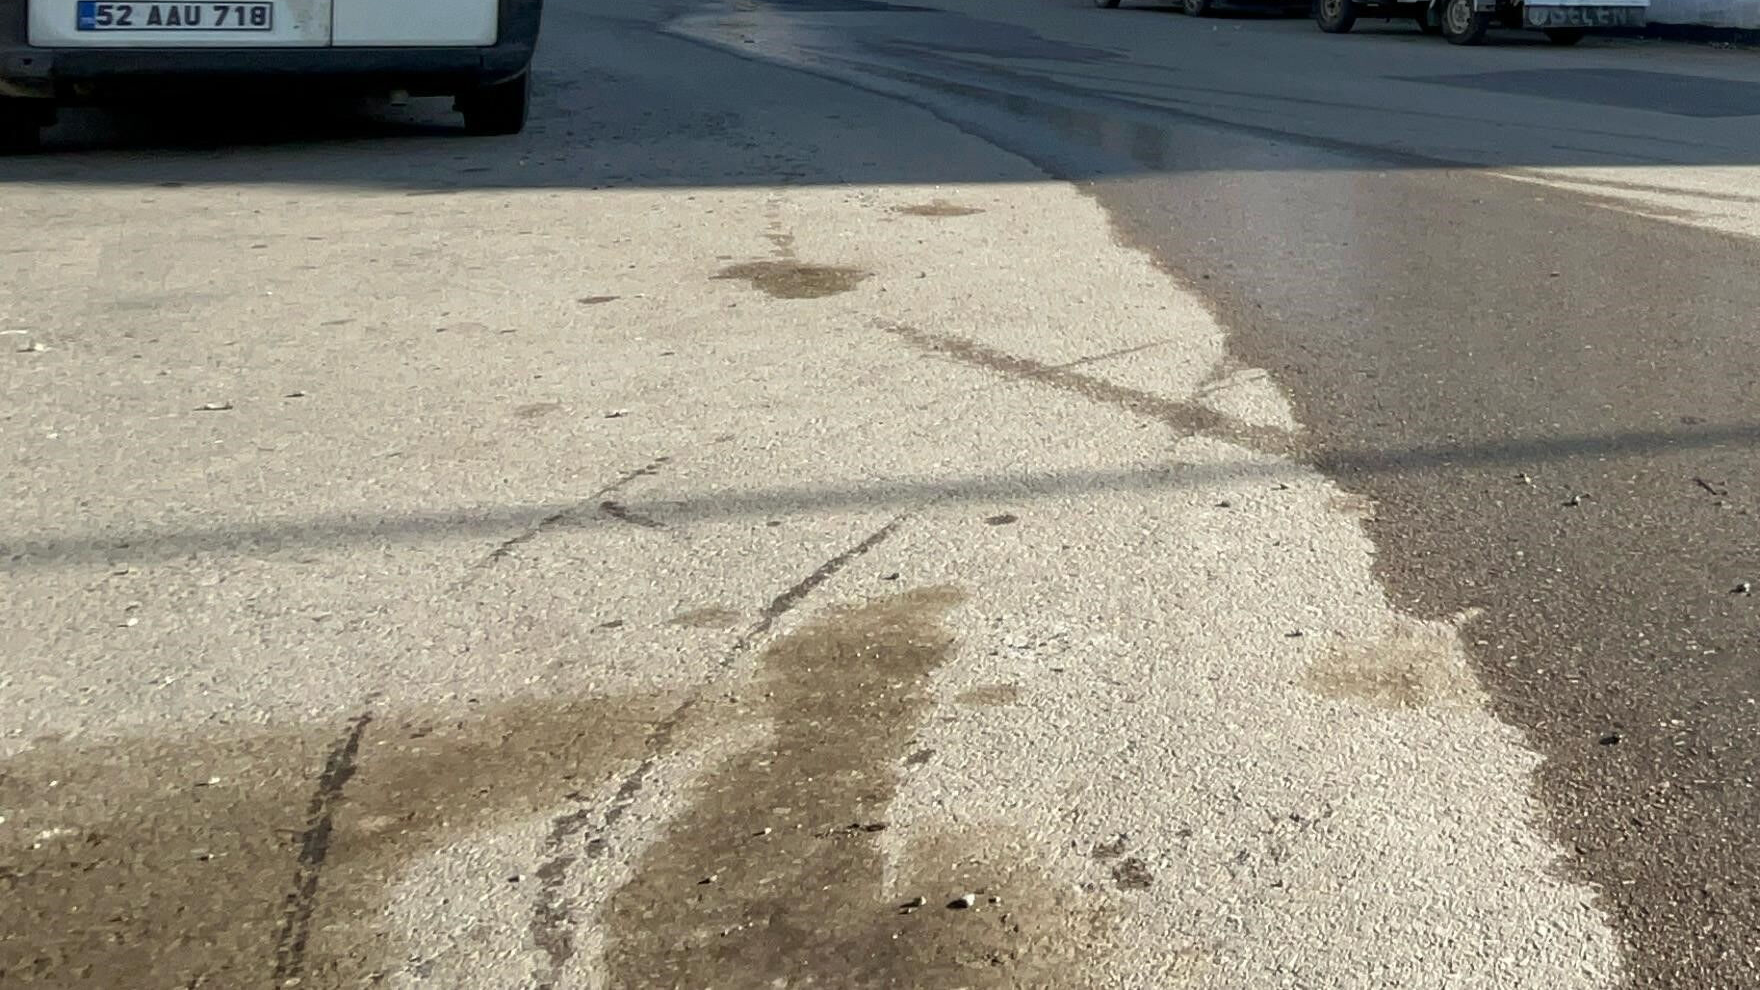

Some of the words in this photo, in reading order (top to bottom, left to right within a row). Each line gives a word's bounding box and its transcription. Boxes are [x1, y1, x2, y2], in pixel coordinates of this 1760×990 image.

[98, 5, 133, 26] 52
[147, 5, 201, 26] AAU
[213, 5, 267, 26] 718
